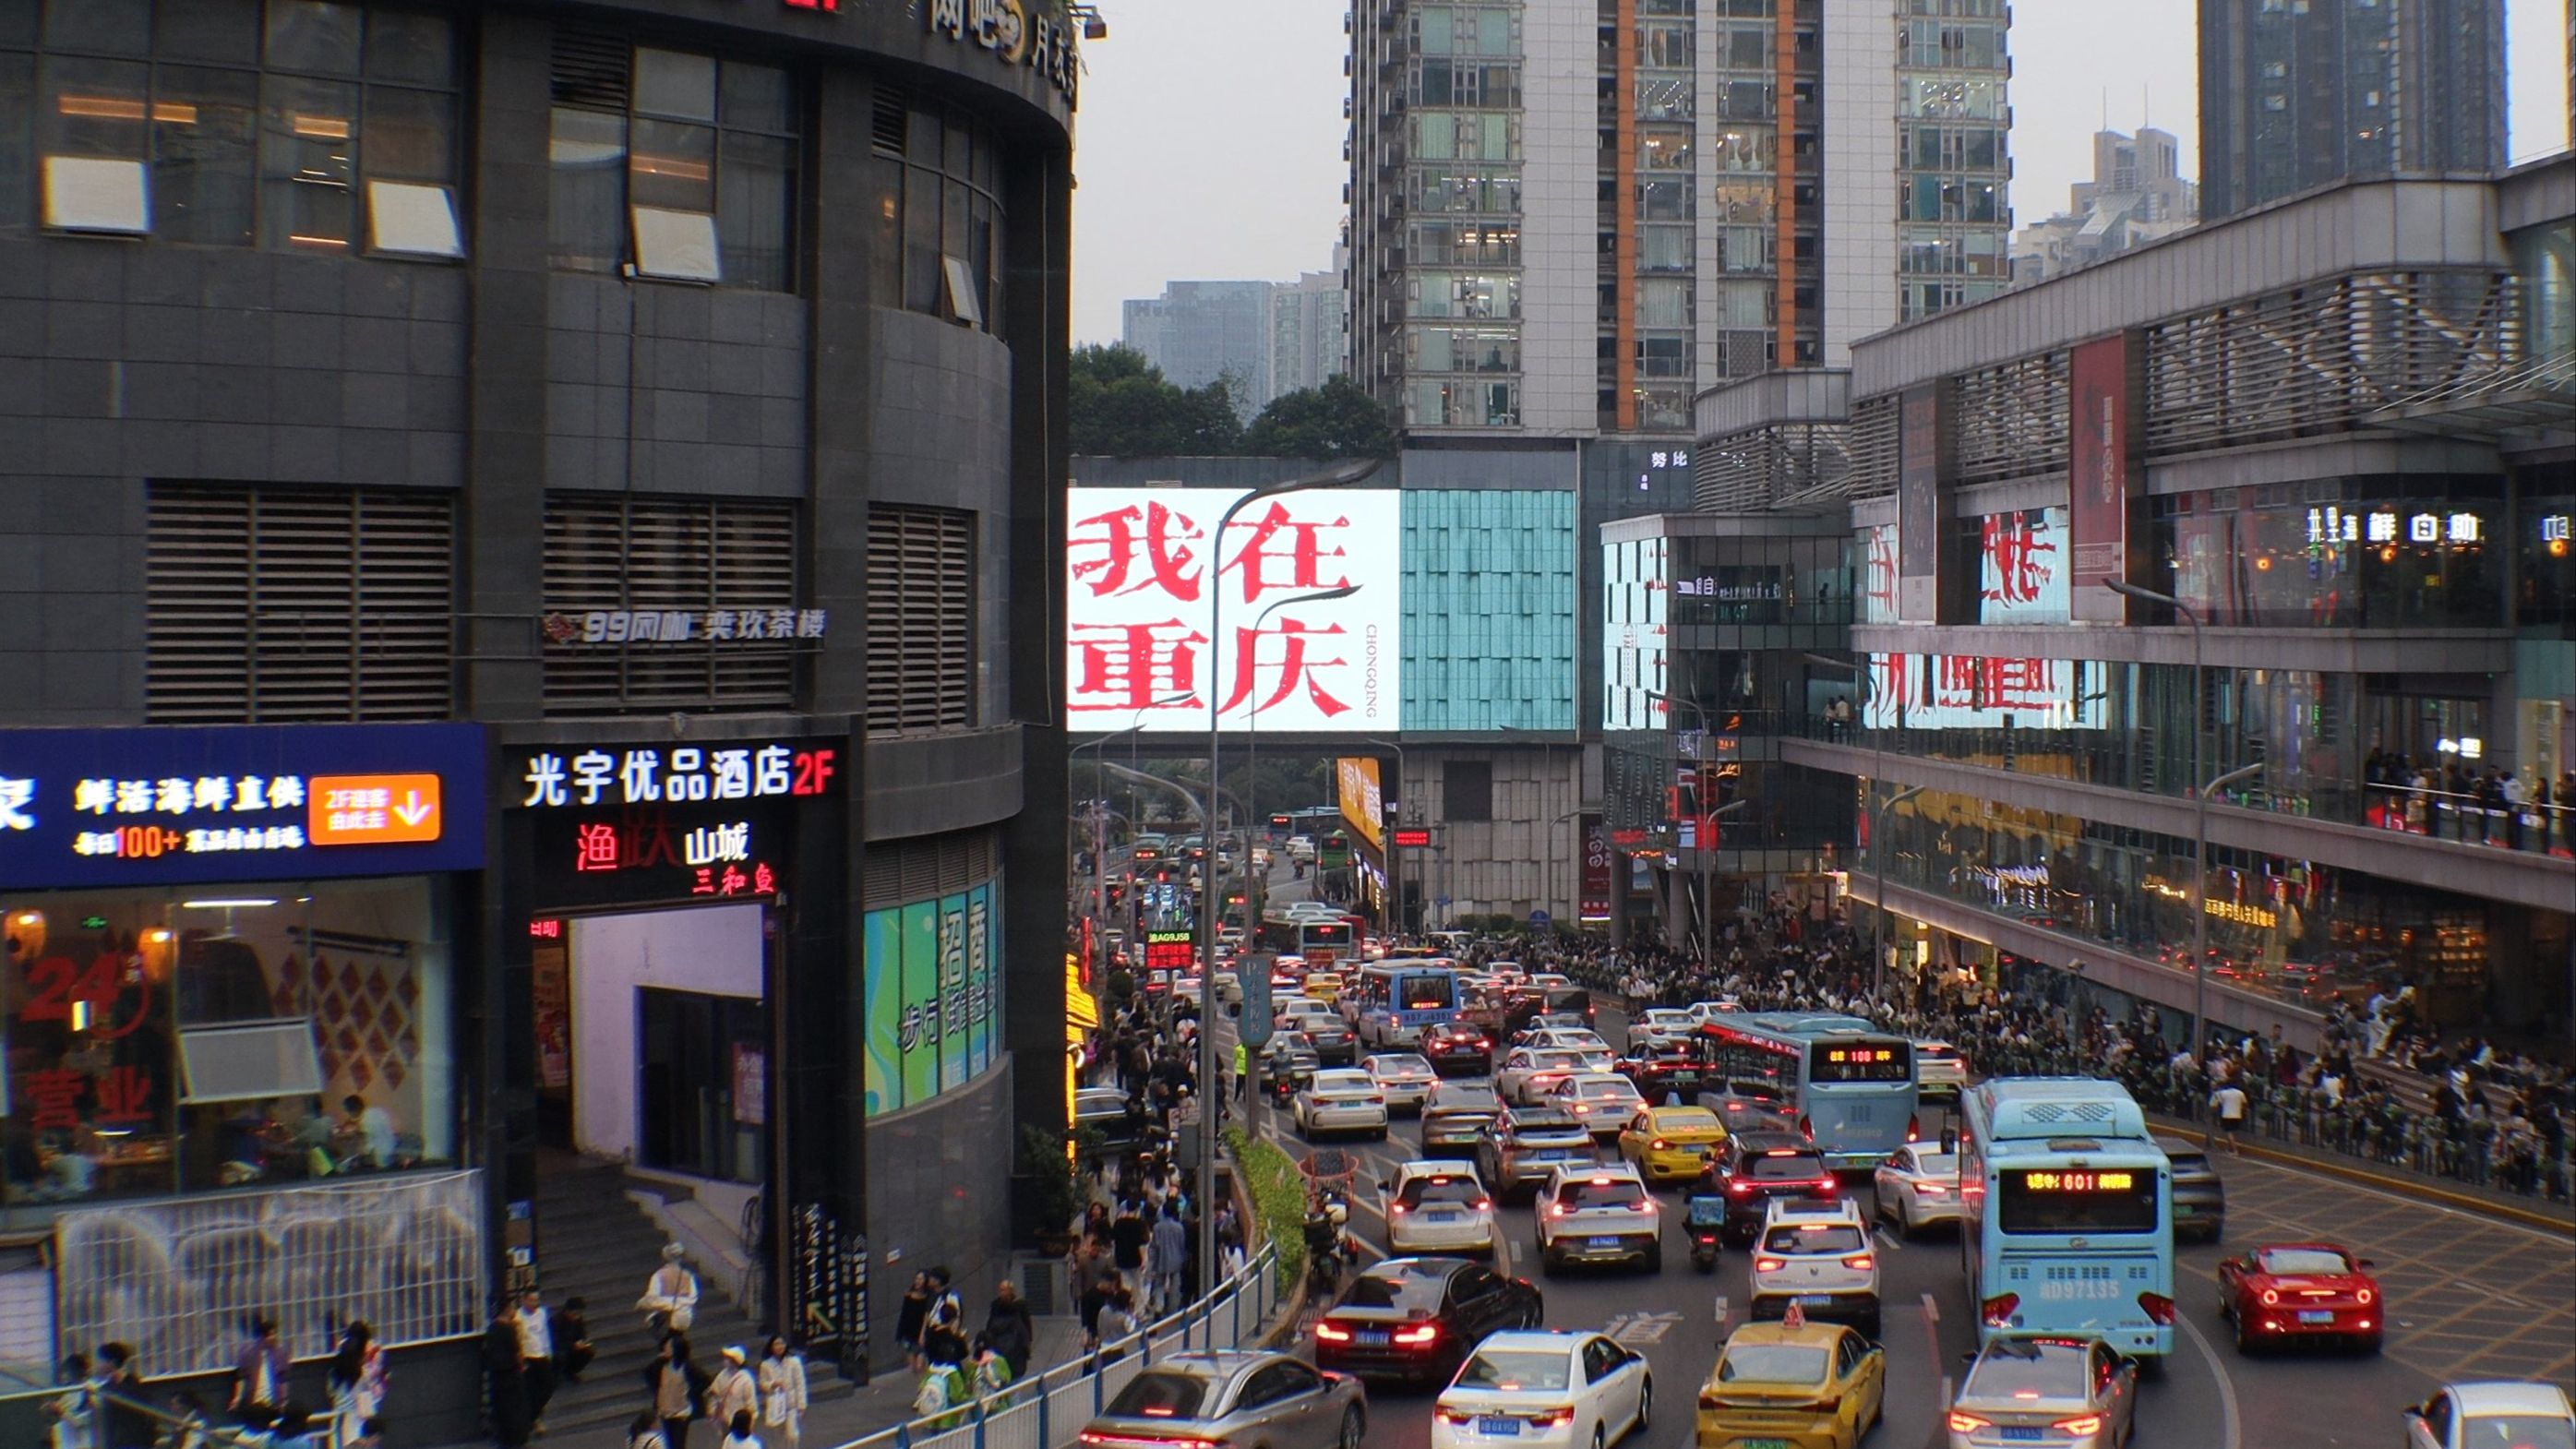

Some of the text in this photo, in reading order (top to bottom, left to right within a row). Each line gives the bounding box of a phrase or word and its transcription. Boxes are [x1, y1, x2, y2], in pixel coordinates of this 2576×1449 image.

[1067, 499, 1351, 604] 我在
[1067, 617, 1353, 718] 重庆
[1365, 624, 1377, 718] CHONGQING
[685, 822, 749, 865] 山城
[2064, 1174, 2093, 1191] 601
